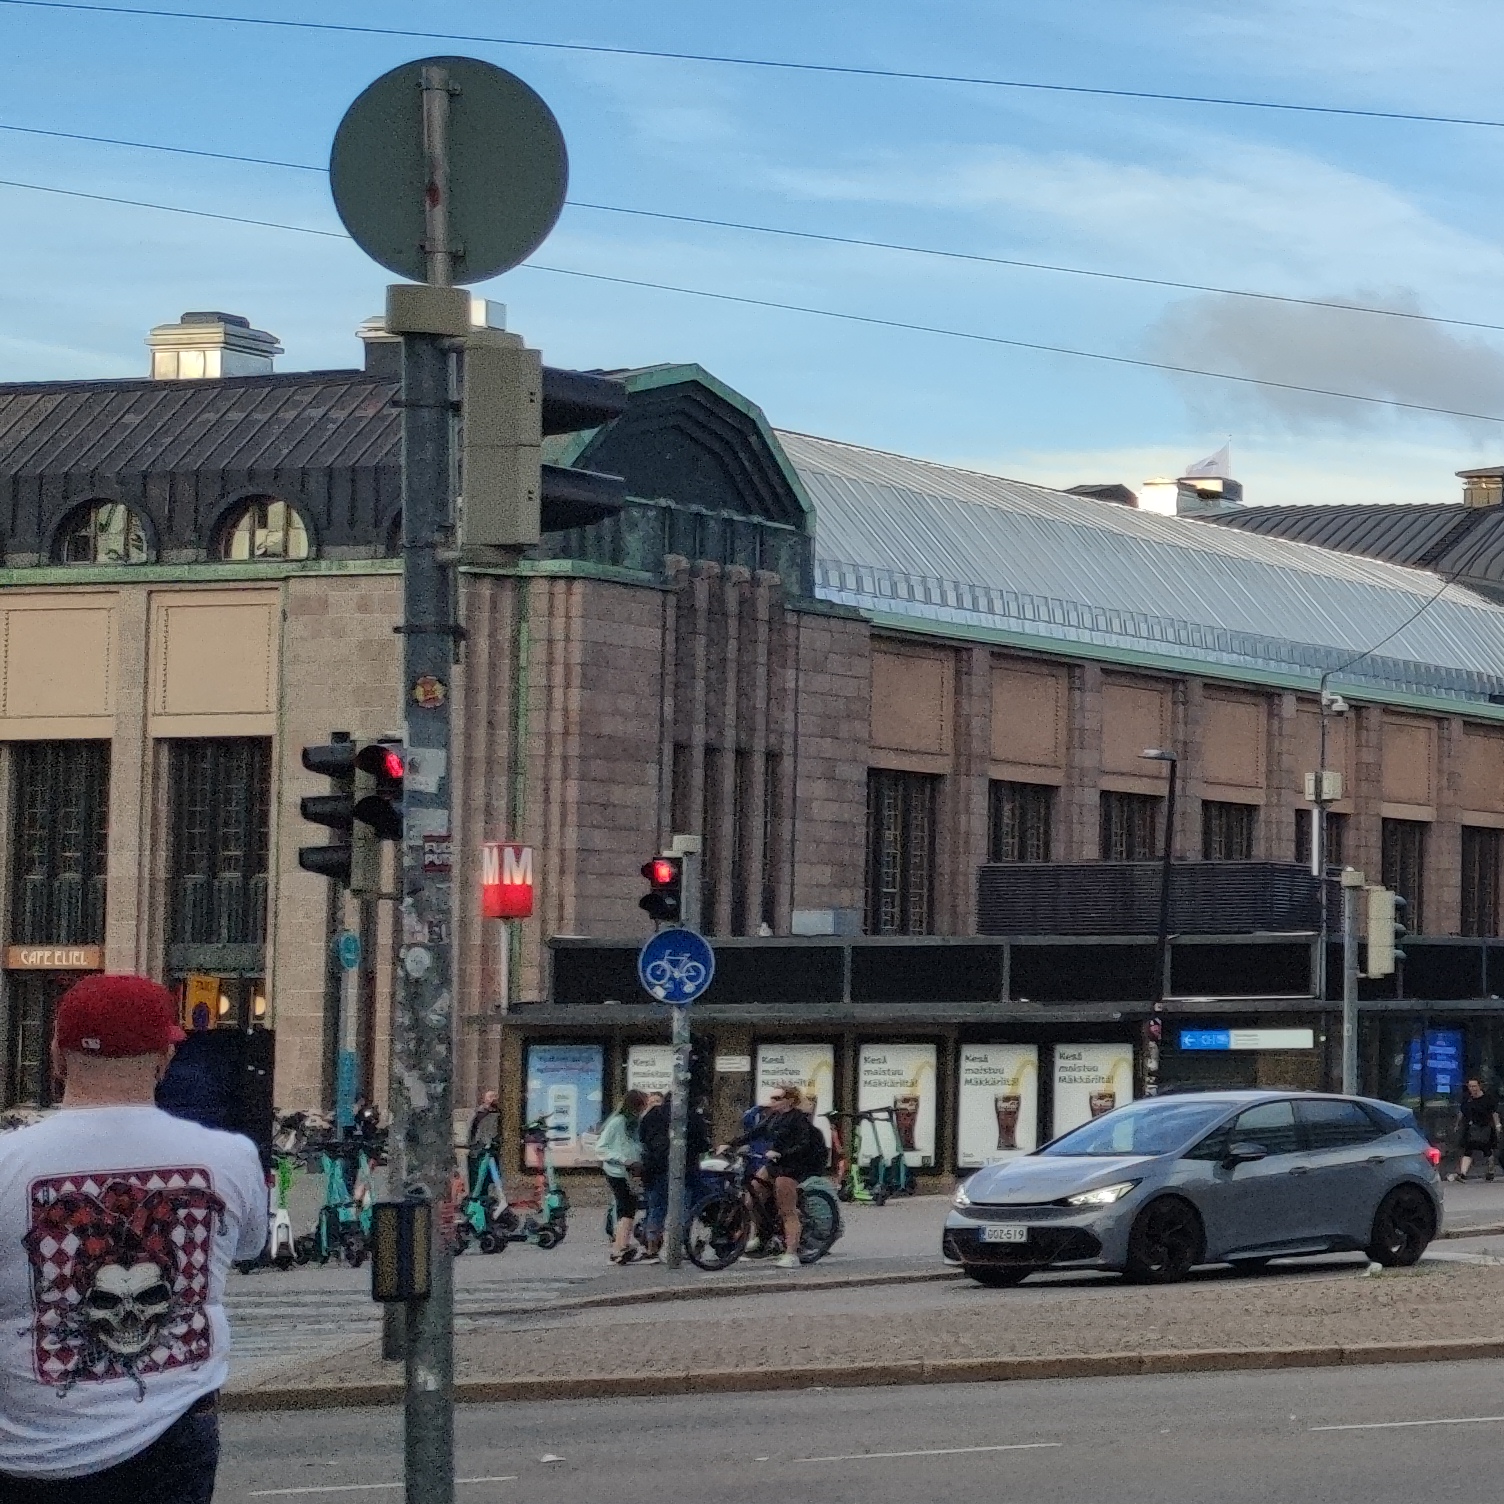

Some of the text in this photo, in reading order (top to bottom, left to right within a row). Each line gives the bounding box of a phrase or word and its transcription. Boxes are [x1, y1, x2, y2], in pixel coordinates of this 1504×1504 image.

[483, 848, 499, 885] M
[503, 848, 532, 885] M
[20, 951, 51, 964] CAFE
